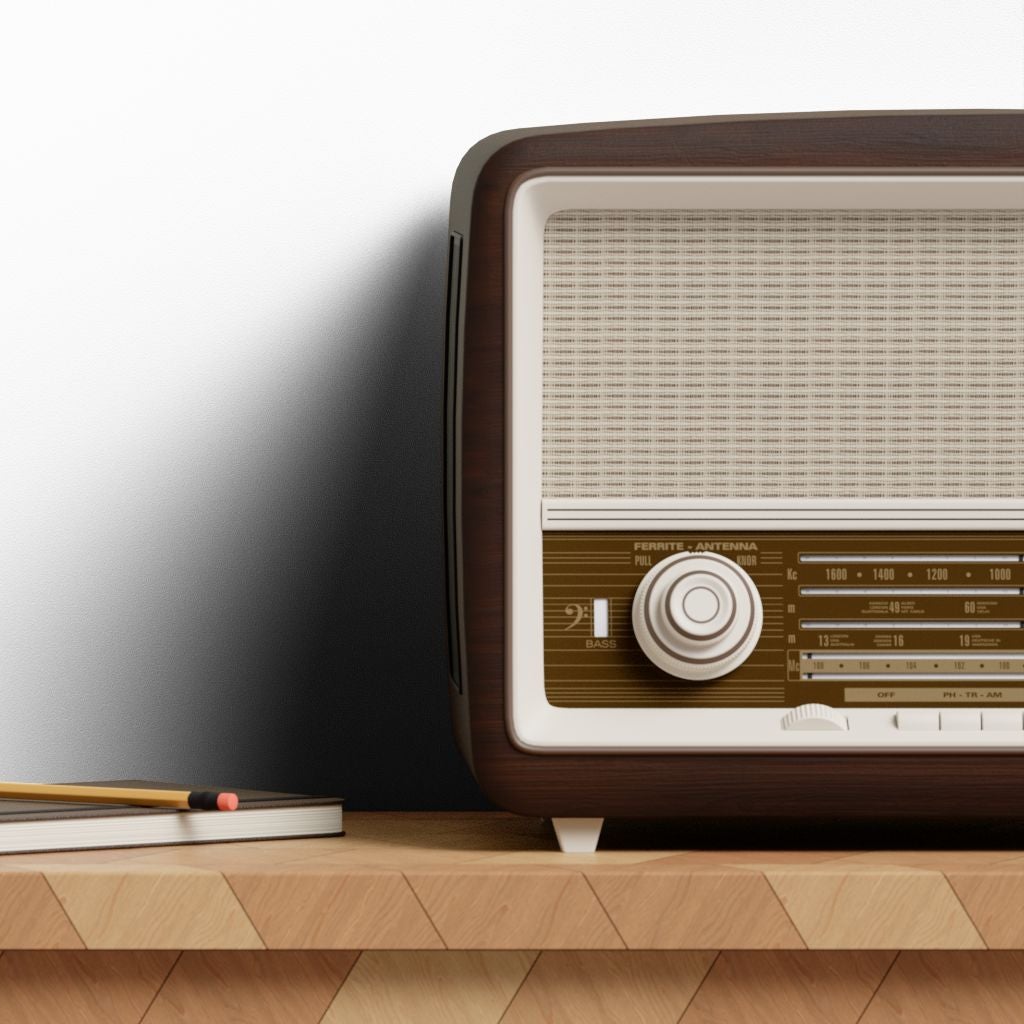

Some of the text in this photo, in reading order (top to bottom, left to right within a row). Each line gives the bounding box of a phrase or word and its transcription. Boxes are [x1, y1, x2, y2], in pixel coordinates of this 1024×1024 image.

[634, 542, 684, 551] FERRITE
[696, 542, 758, 551] ANTENNA
[635, 555, 652, 566] PULL
[787, 568, 1011, 580] Kc 1600 1400 1200 1000
[889, 601, 900, 613] 49
[964, 601, 976, 613] 60
[585, 639, 617, 649] BASS
[819, 634, 829, 647] 13
[893, 634, 904, 647] 16
[959, 634, 970, 647] 19
